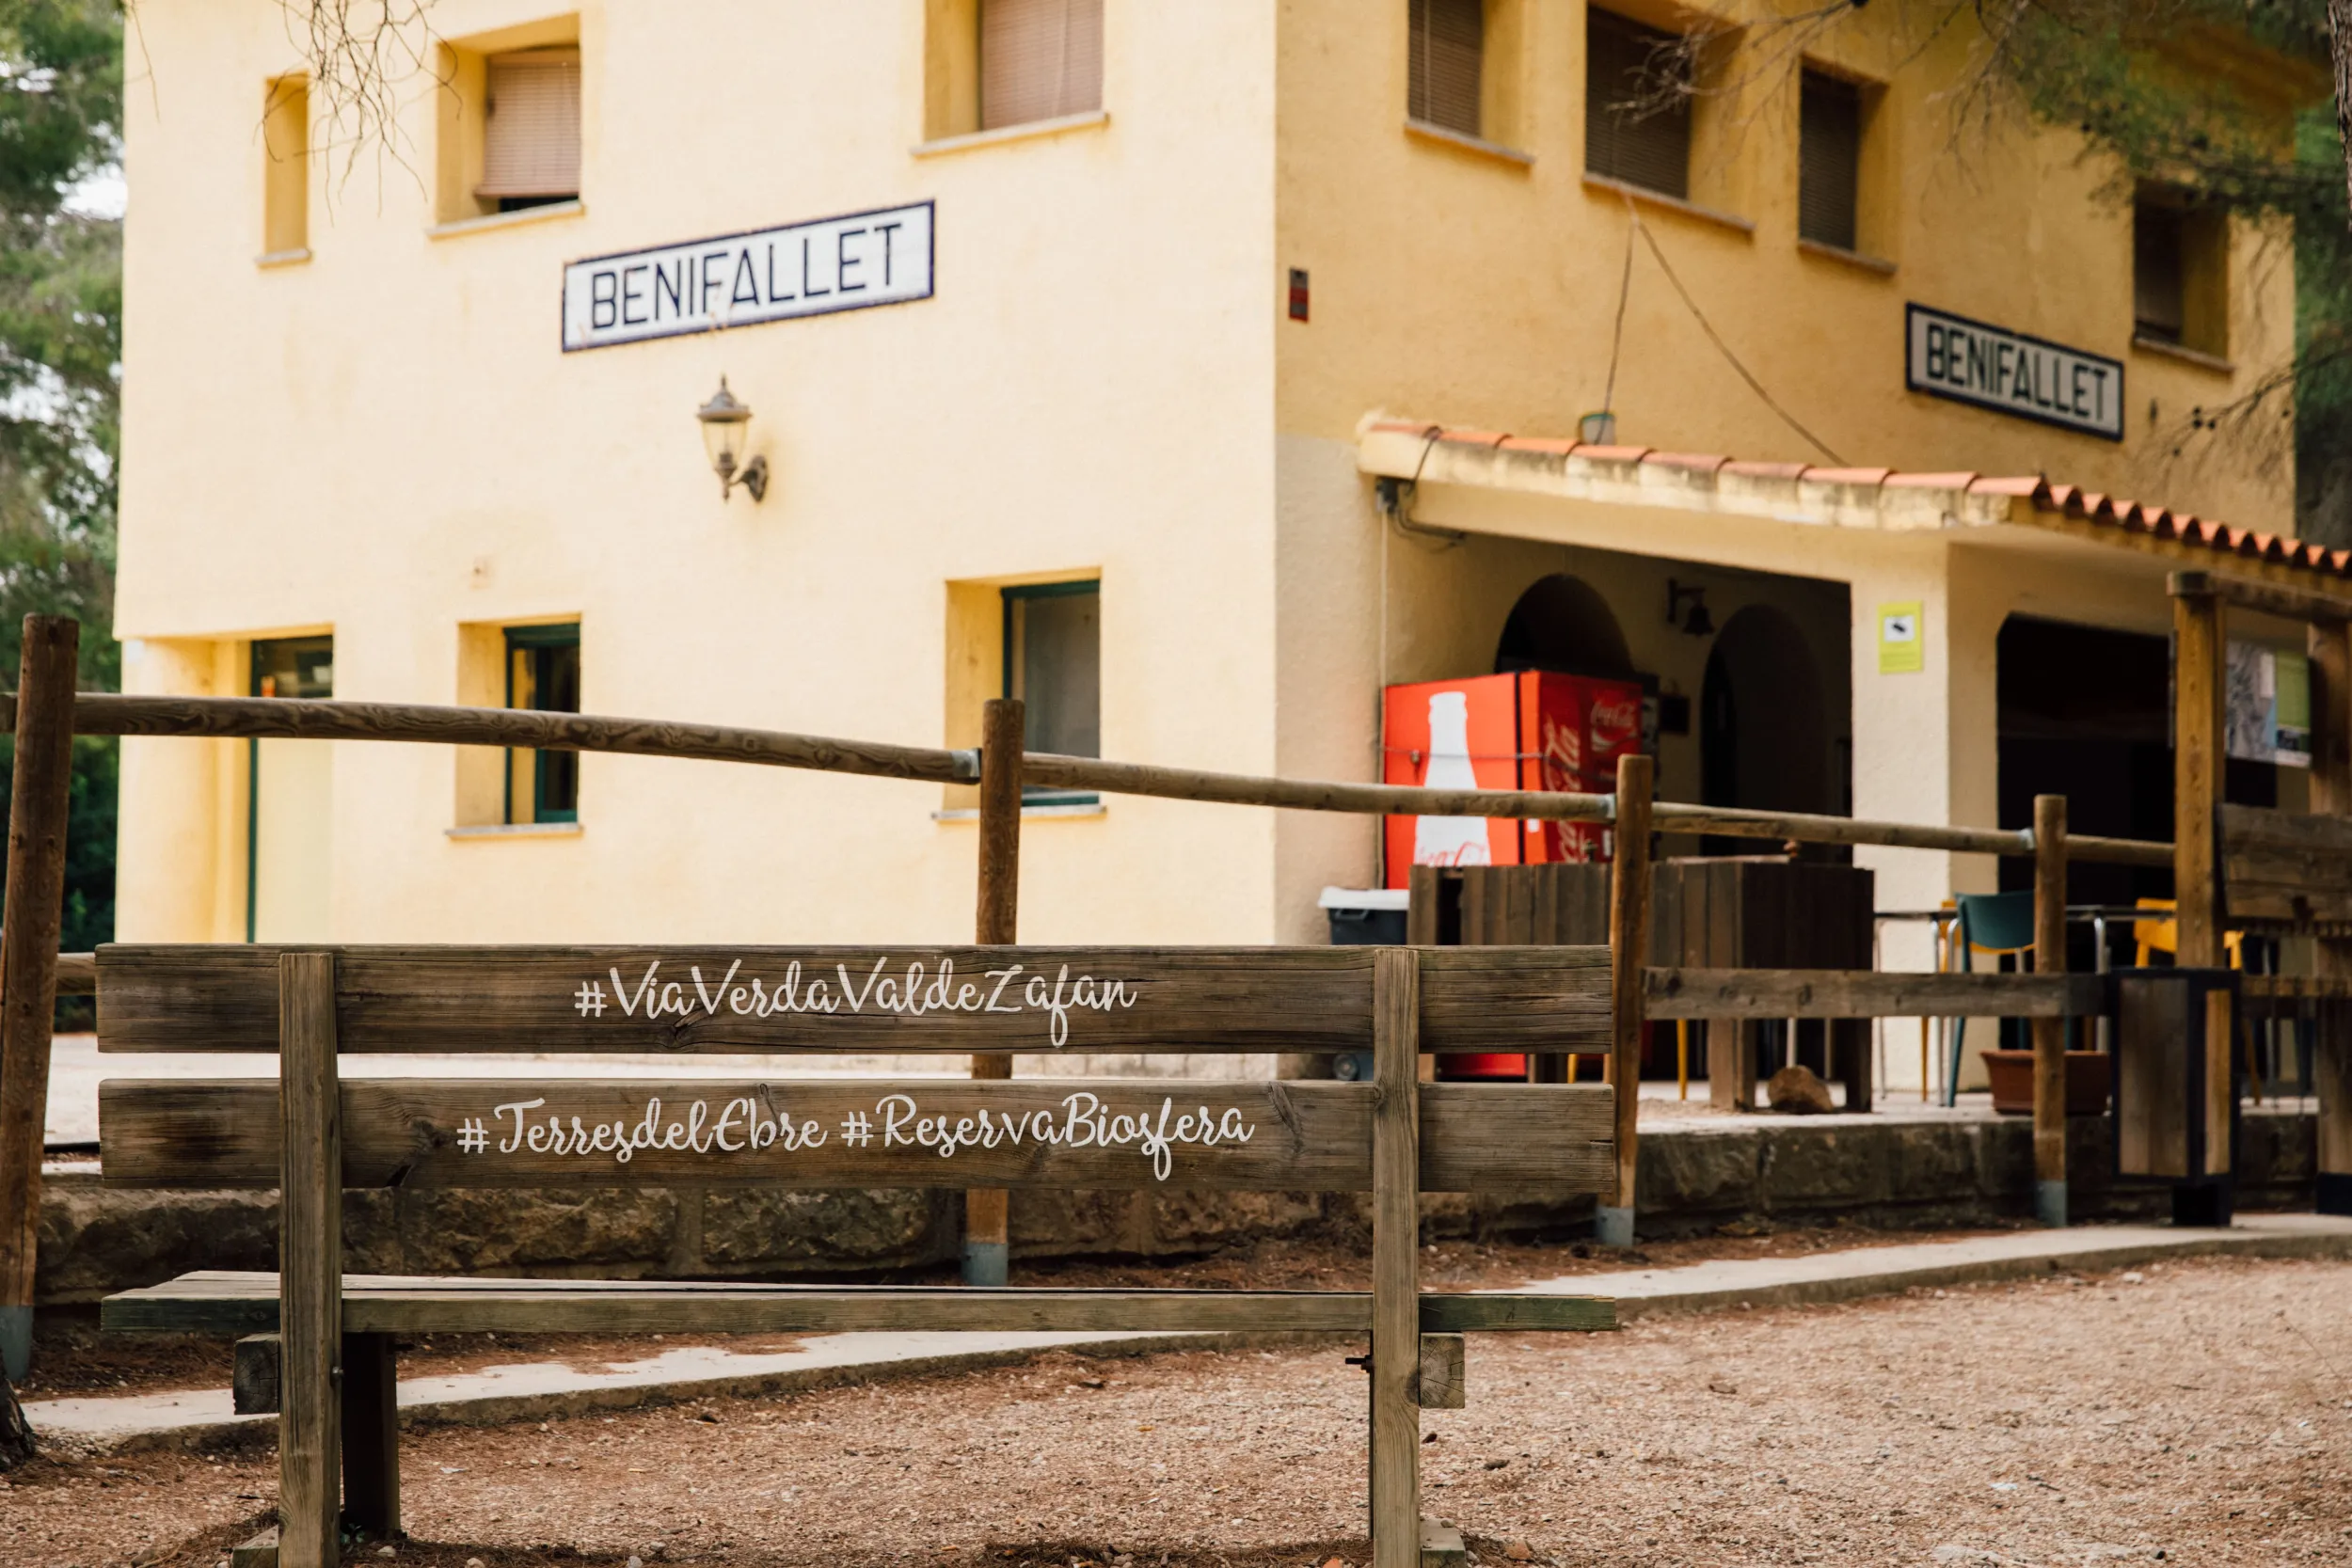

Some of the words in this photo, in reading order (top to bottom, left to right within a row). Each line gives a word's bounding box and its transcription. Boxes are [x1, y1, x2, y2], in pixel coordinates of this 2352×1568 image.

[591, 222, 902, 330] BENIFALLET
[1927, 323, 2108, 421] BENIFALLET
[574, 957, 1137, 1048] #ViaVerdaValdeZafan
[456, 1097, 828, 1164] #TerresdelEbre
[840, 1092, 1255, 1181] #ReservaBiosfera
